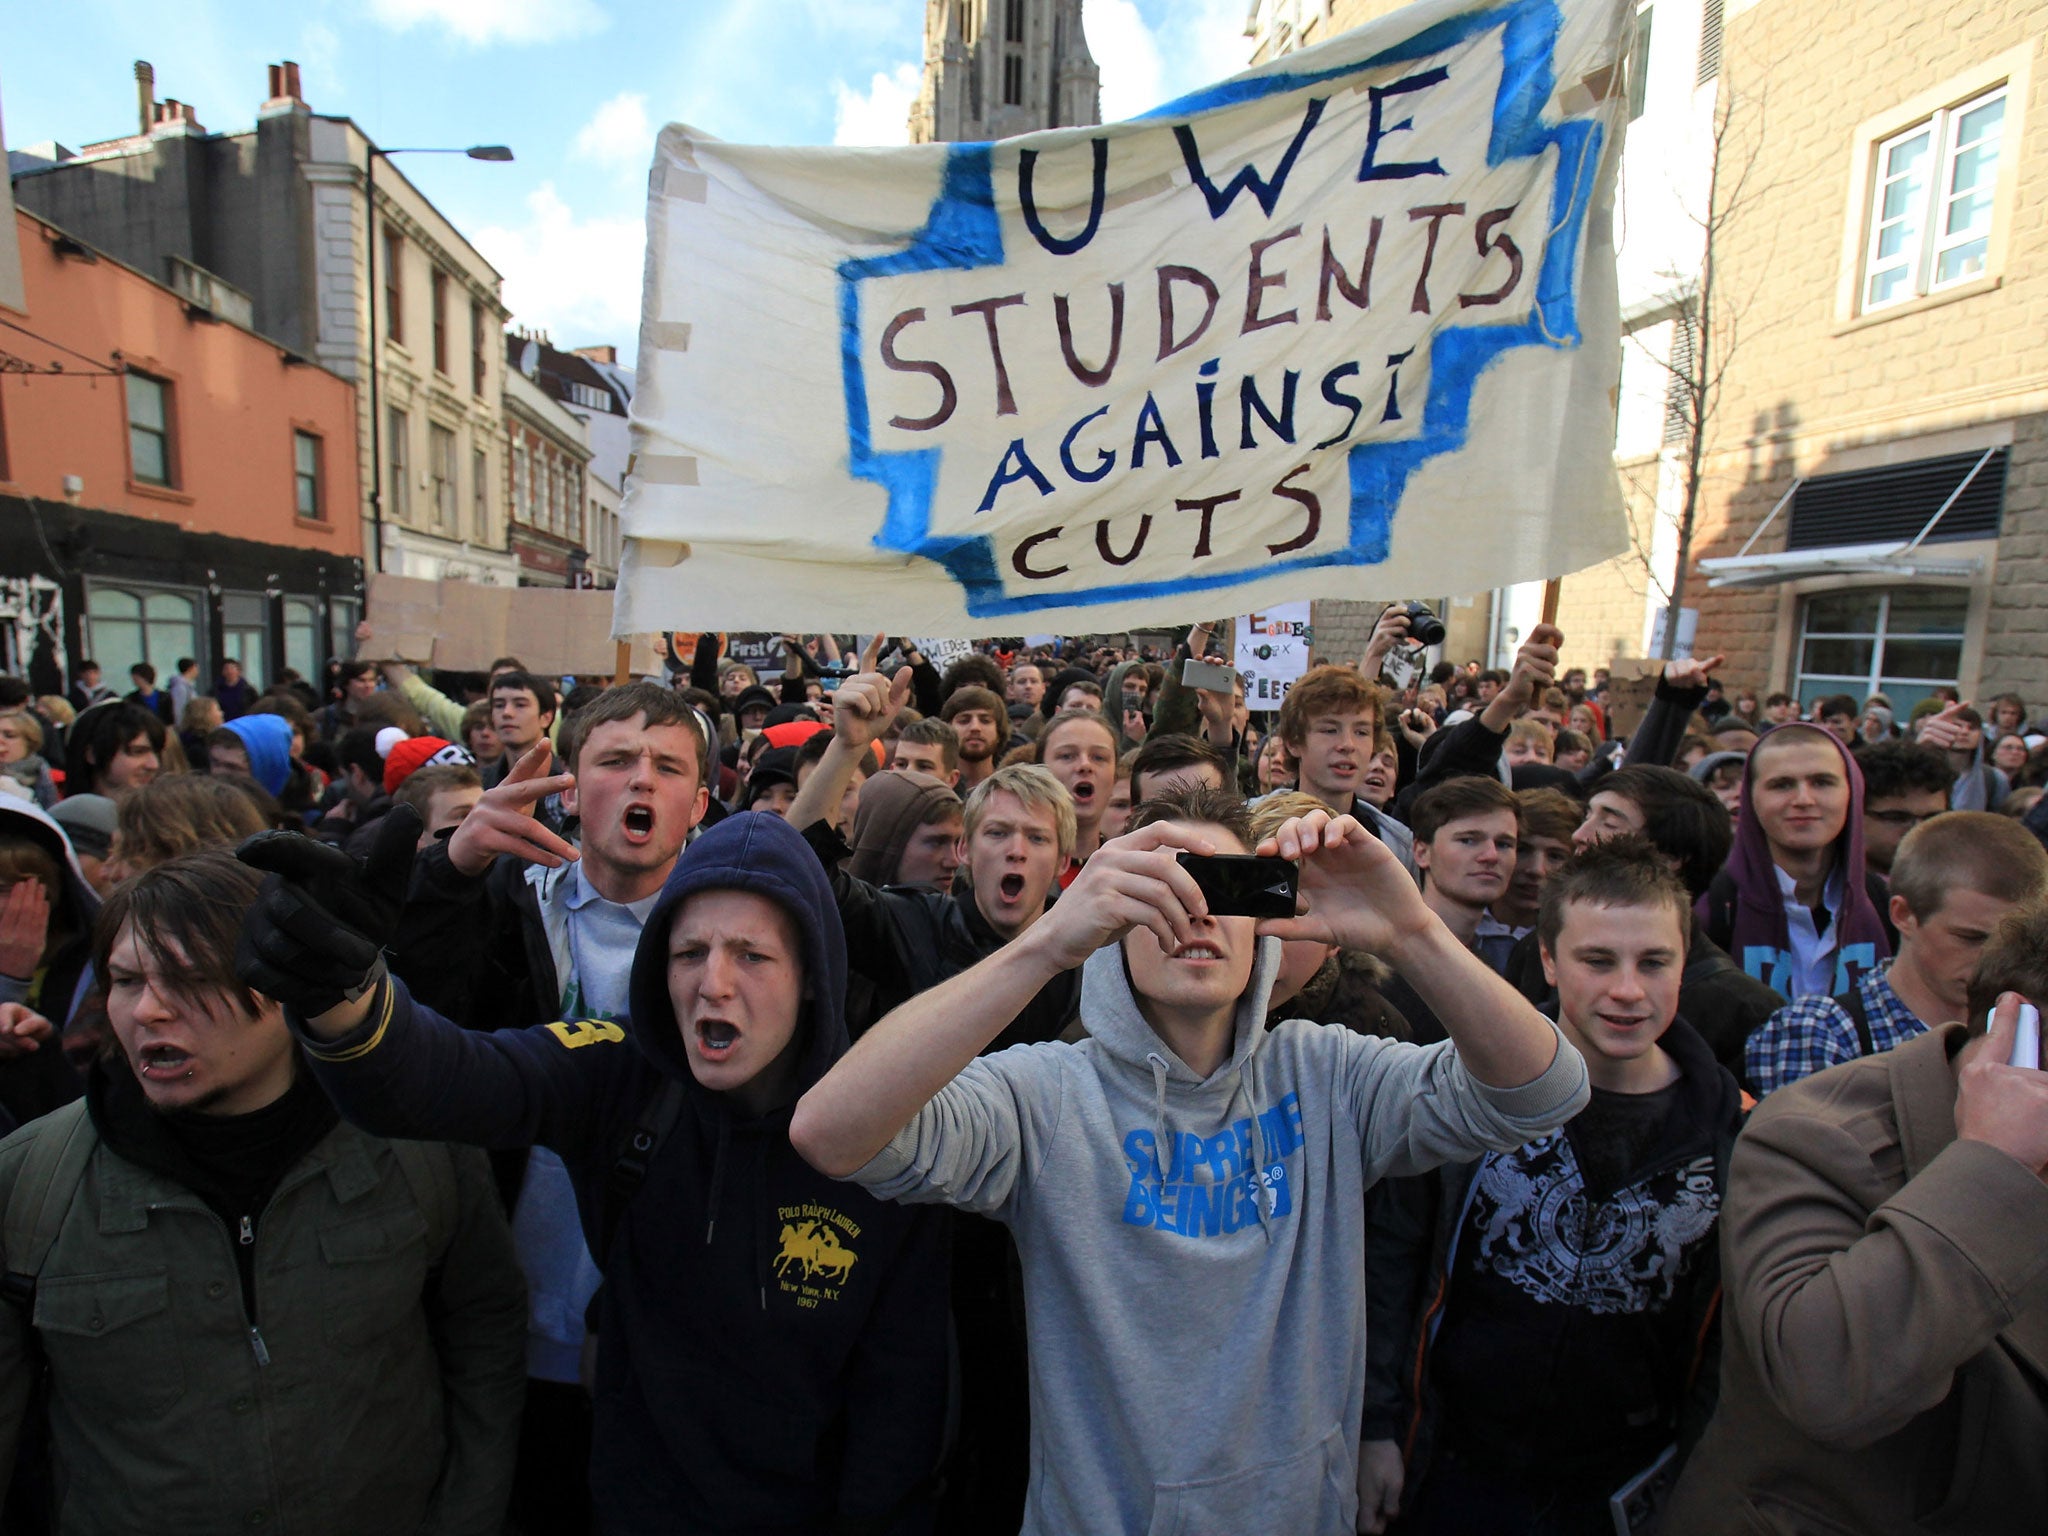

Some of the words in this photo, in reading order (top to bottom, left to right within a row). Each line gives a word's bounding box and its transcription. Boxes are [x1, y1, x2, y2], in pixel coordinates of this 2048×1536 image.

[881, 202, 1523, 432] STUDENTS
[1011, 463, 1322, 579] CUTS
[730, 640, 765, 656] First
[1122, 1090, 1305, 1183] SUPREME
[778, 1206, 800, 1221] POLO
[801, 1204, 830, 1220] RALPH
[829, 1208, 862, 1239] LAUREN
[780, 1280, 799, 1293] NEW
[796, 1296, 819, 1309] 1967
